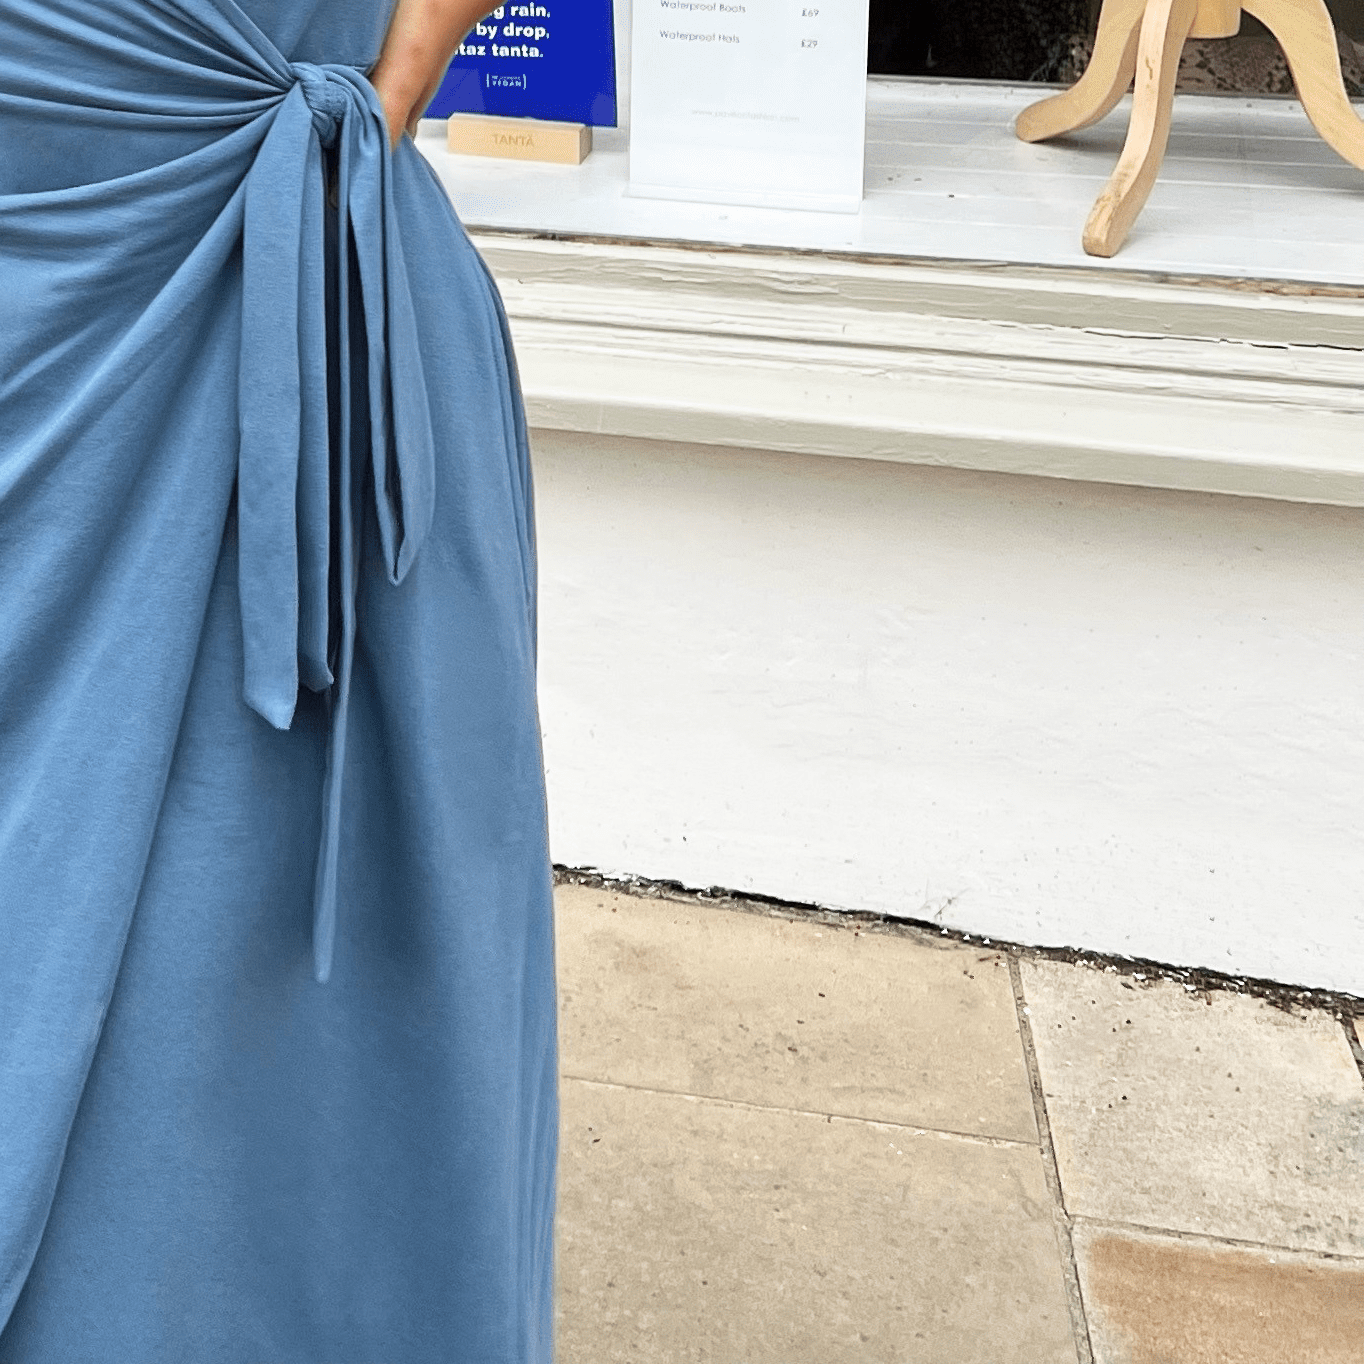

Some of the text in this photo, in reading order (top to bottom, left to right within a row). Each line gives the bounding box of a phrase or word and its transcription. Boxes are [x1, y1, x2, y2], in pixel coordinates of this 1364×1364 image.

[660, 0, 746, 13] Waterproof Boots
[476, 21, 550, 41] by drop,
[659, 30, 716, 42] Waterproof
[491, 42, 544, 58] tanta.
